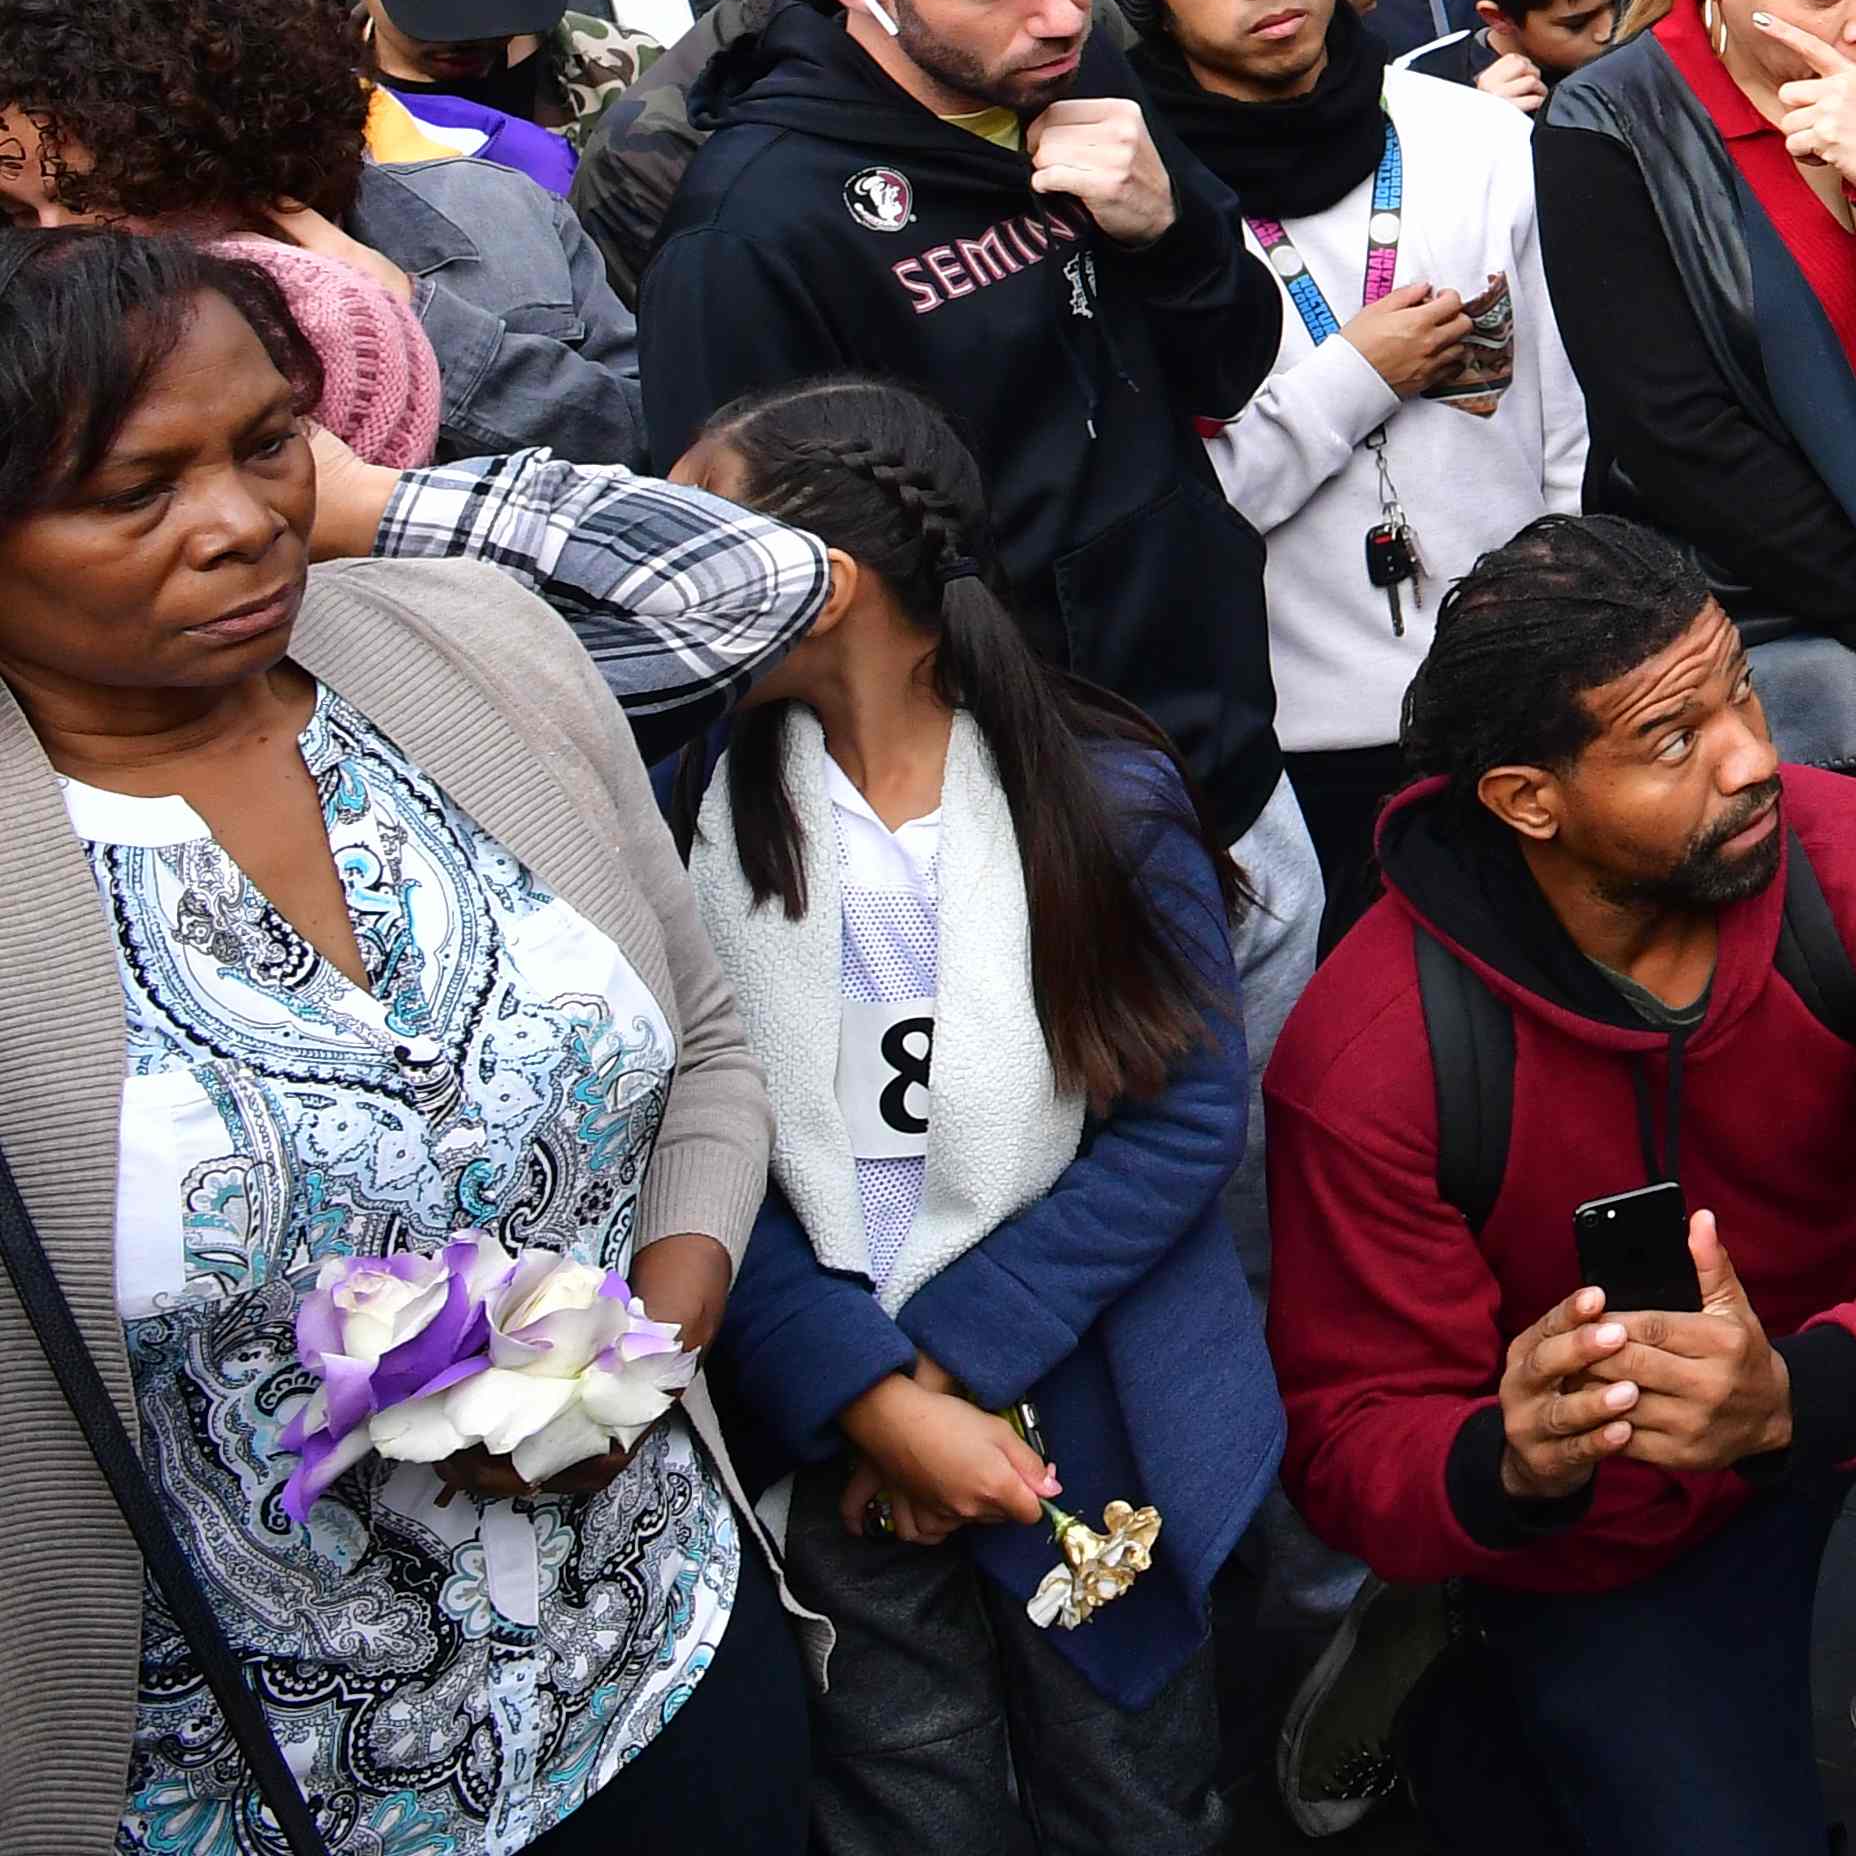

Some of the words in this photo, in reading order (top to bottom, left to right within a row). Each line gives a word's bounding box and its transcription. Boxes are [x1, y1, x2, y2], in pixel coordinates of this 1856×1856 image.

[1289, 280, 1328, 345] WONDER
[1300, 273, 1341, 334] NOCTUR
[879, 1016, 935, 1135] 8
